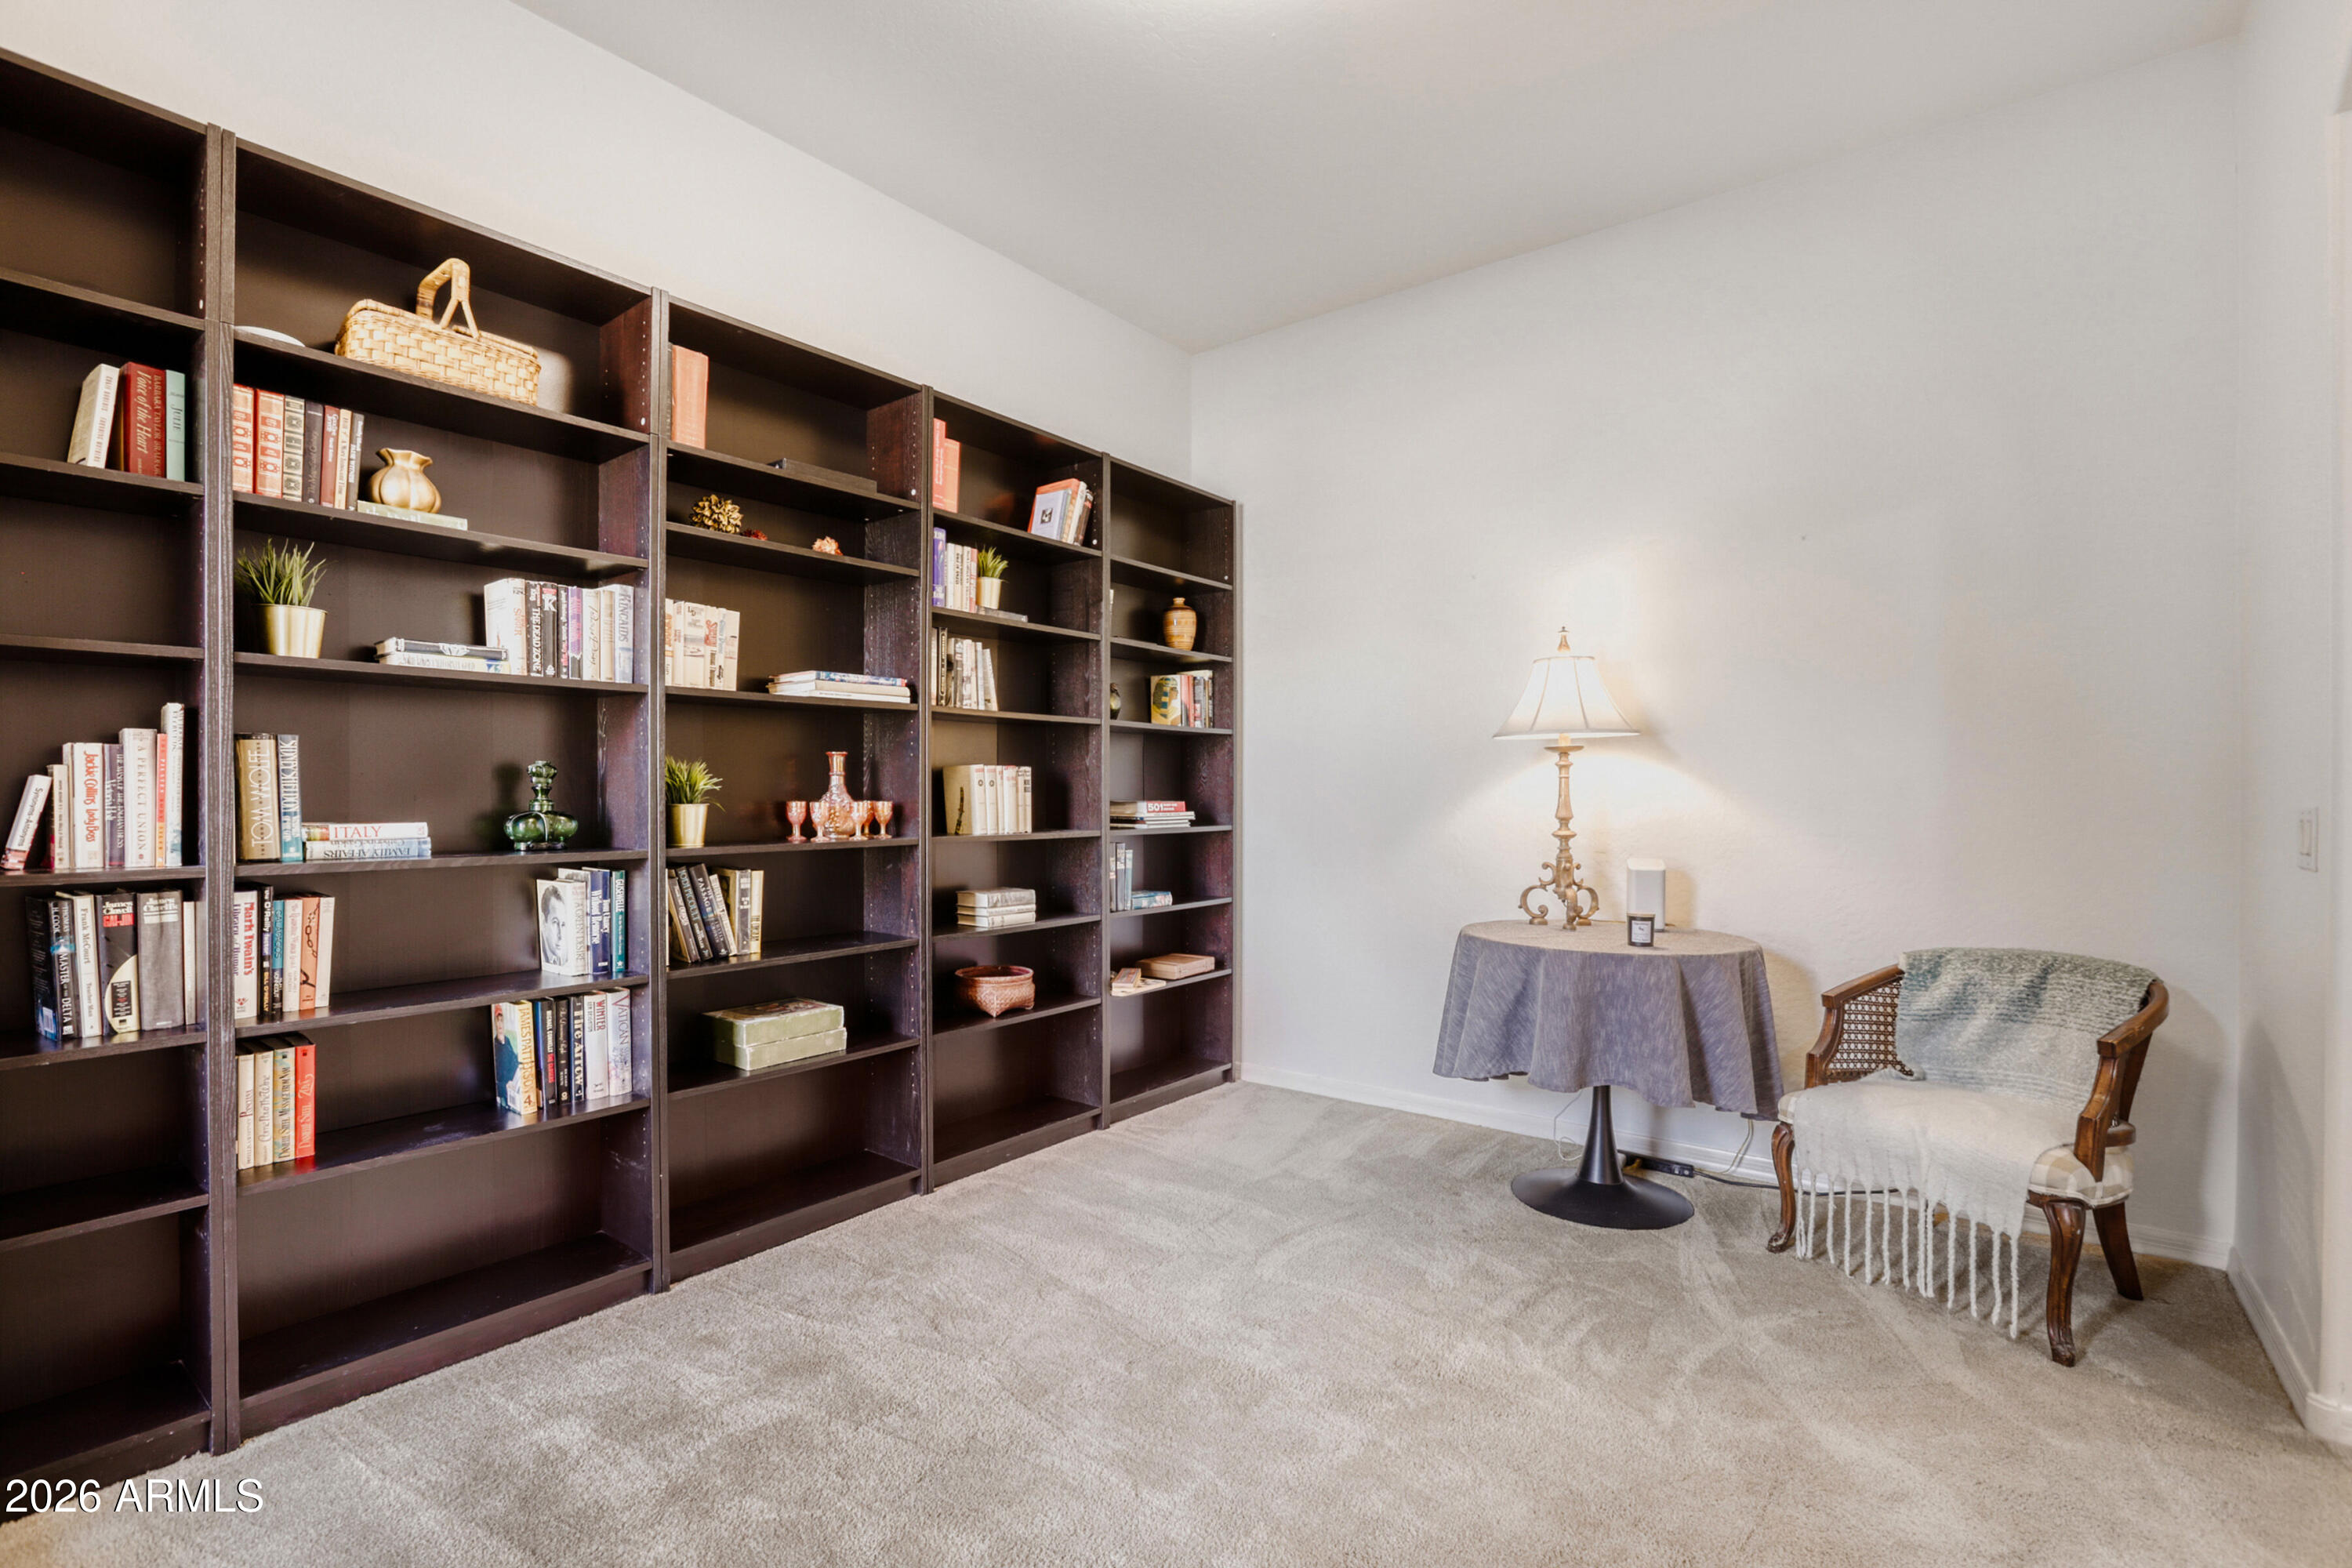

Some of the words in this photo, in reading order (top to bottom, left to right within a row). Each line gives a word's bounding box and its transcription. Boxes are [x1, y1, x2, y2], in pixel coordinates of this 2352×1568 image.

[136, 370, 152, 397] Voice
[153, 374, 162, 410] BARBARA
[134, 394, 151, 411] of
[136, 406, 151, 425] the
[169, 404, 183, 433] JULIE
[136, 423, 152, 455] Heart
[532, 608, 541, 625] THE
[543, 593, 557, 612] K
[532, 624, 541, 648] DEAD
[532, 648, 541, 672] ZONE
[84, 750, 99, 778] Jackie
[279, 739, 299, 772] SIDNEY
[137, 757, 146, 806] PERFECT
[247, 748, 272, 801] WOLFE
[84, 779, 99, 806] Collins
[281, 771, 299, 813] SHELDON
[1147, 802, 1164, 812] 501
[84, 808, 99, 826] Lady
[137, 812, 146, 850] UNION
[250, 807, 274, 848] TOM
[85, 826, 100, 843] Boss
[334, 826, 382, 839] ITALY
[323, 849, 368, 858] AFFAIRS
[372, 847, 411, 858] FAMILY
[591, 889, 602, 915] Without
[685, 888, 700, 921] PICOULT
[697, 877, 712, 913] PASSAGE
[80, 908, 89, 931] Frank
[244, 902, 255, 932] Mark
[263, 901, 272, 933] O'Reilly
[591, 915, 602, 946] Remorse
[82, 933, 91, 964] McCourt
[244, 933, 255, 976] Twain's
[59, 953, 70, 984] MASTER
[61, 996, 73, 1022] DELTA
[518, 1007, 531, 1039] JAMES
[596, 1000, 606, 1031] WINTER
[612, 994, 630, 1045] VATICAN
[521, 1039, 534, 1094] PATTERSON
[574, 1041, 583, 1086] Arrow
